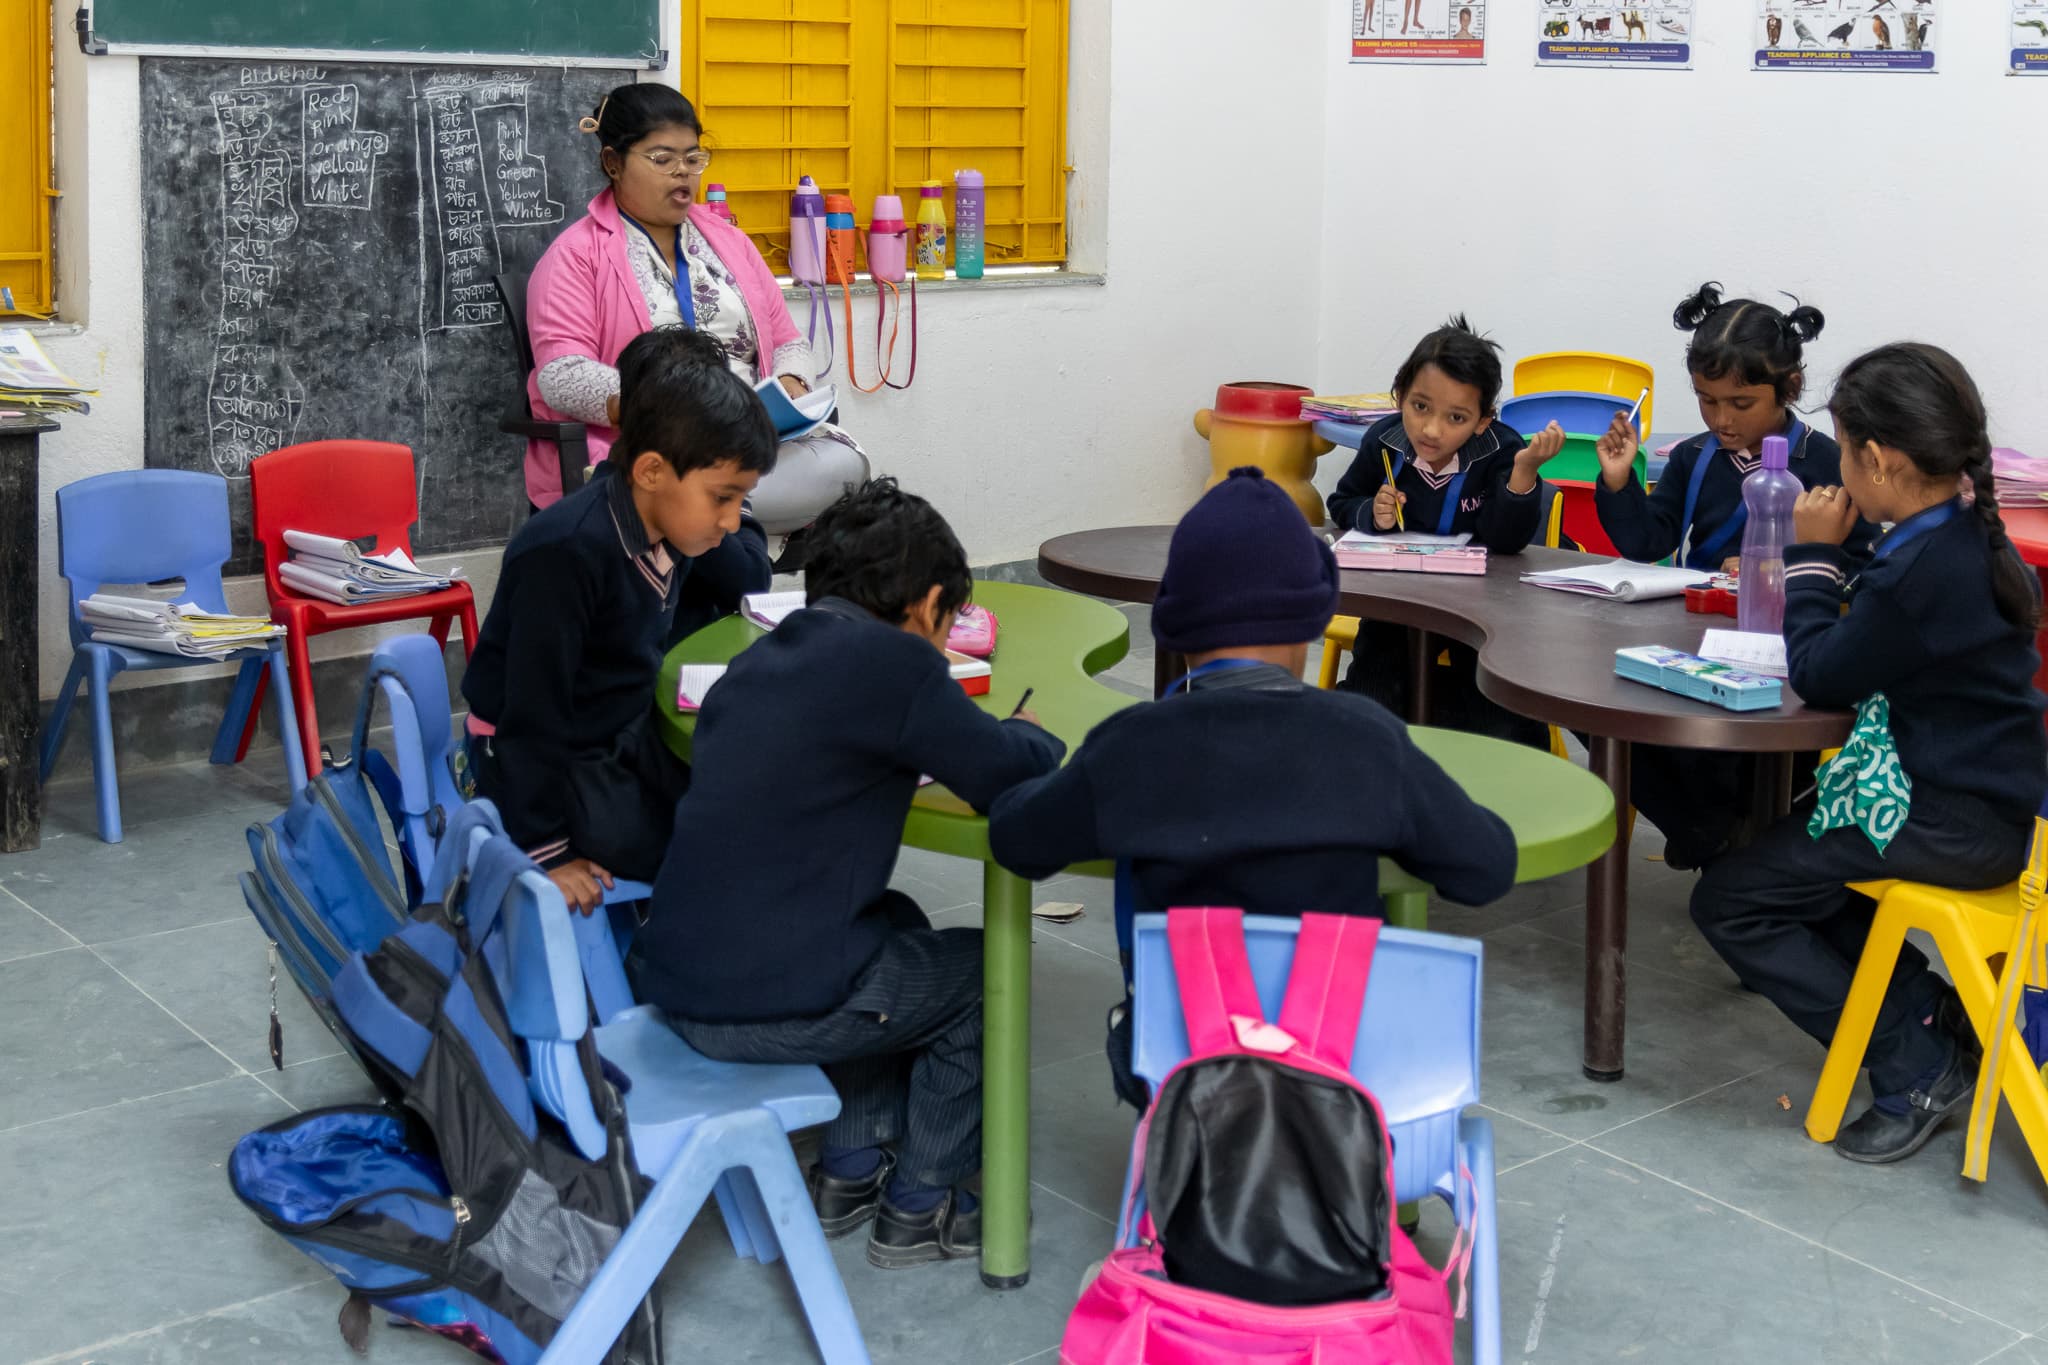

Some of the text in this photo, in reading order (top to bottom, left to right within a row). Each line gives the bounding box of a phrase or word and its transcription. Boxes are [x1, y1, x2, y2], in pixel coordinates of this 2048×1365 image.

[1801, 51, 1839, 59] APPLIANCE
[309, 85, 350, 114] Red
[497, 119, 522, 140] Pink
[499, 138, 523, 162] Red
[496, 163, 536, 181] Green
[499, 183, 541, 201] Yellow
[504, 199, 553, 219] White
